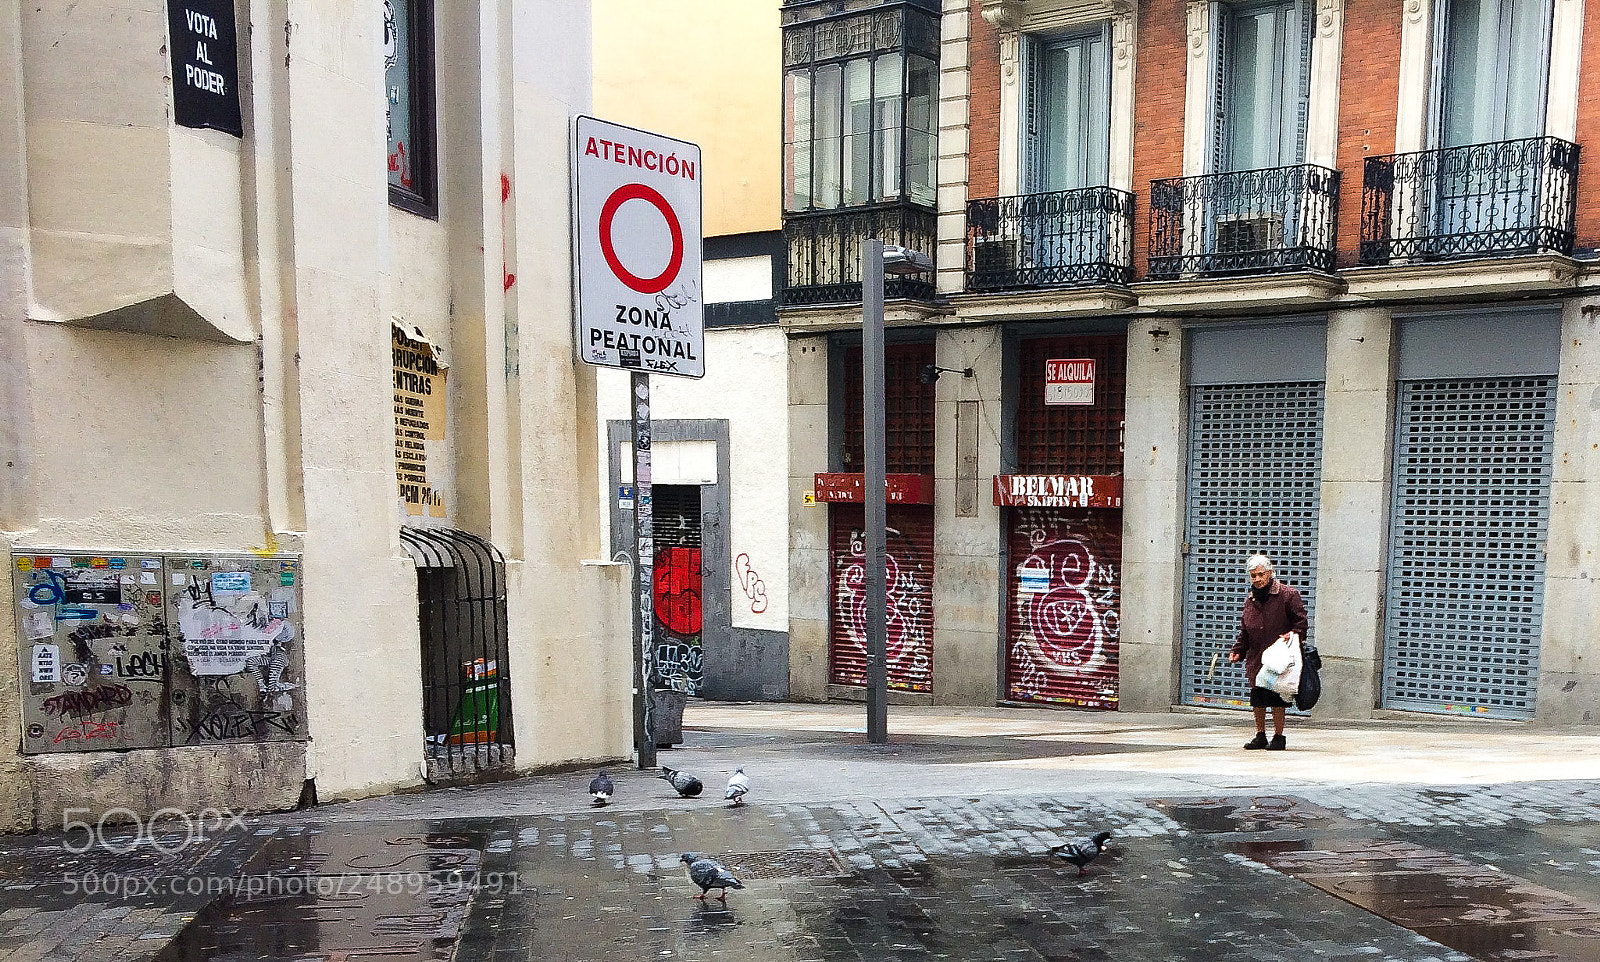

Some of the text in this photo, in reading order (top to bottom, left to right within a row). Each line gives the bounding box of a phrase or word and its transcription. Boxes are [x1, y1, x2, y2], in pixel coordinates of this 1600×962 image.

[185, 9, 218, 40] VOTA
[196, 41, 213, 66] AL
[185, 64, 225, 96] PODER
[584, 136, 695, 181] ATENCIÓN
[616, 304, 672, 331] ZONA
[590, 328, 697, 361] PEATONAL
[1047, 363, 1093, 381] SE ALQUILA
[1011, 476, 1095, 497] BELMAR
